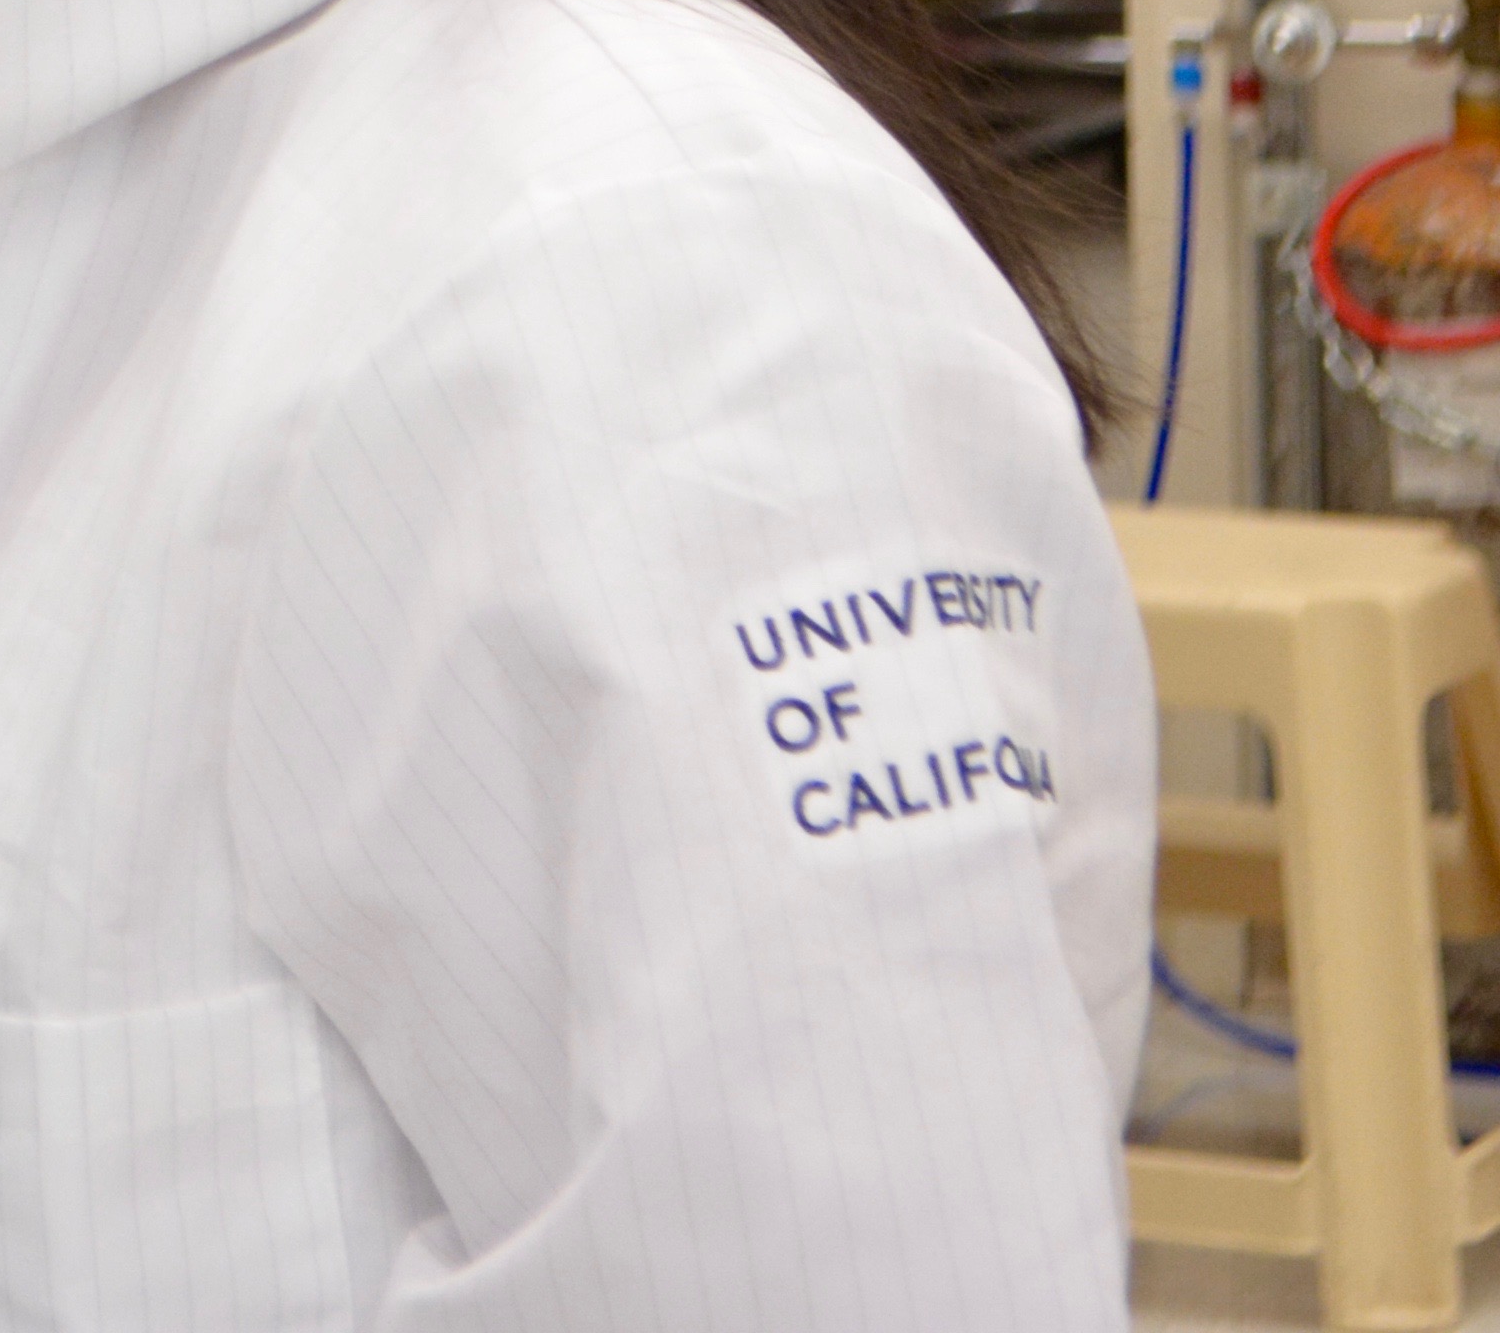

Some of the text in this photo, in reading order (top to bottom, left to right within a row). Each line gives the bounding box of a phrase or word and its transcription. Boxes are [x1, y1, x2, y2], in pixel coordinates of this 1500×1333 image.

[735, 572, 1042, 671] UNIVERSITY
[765, 682, 862, 753] OF
[793, 735, 1058, 838] CALIFO
